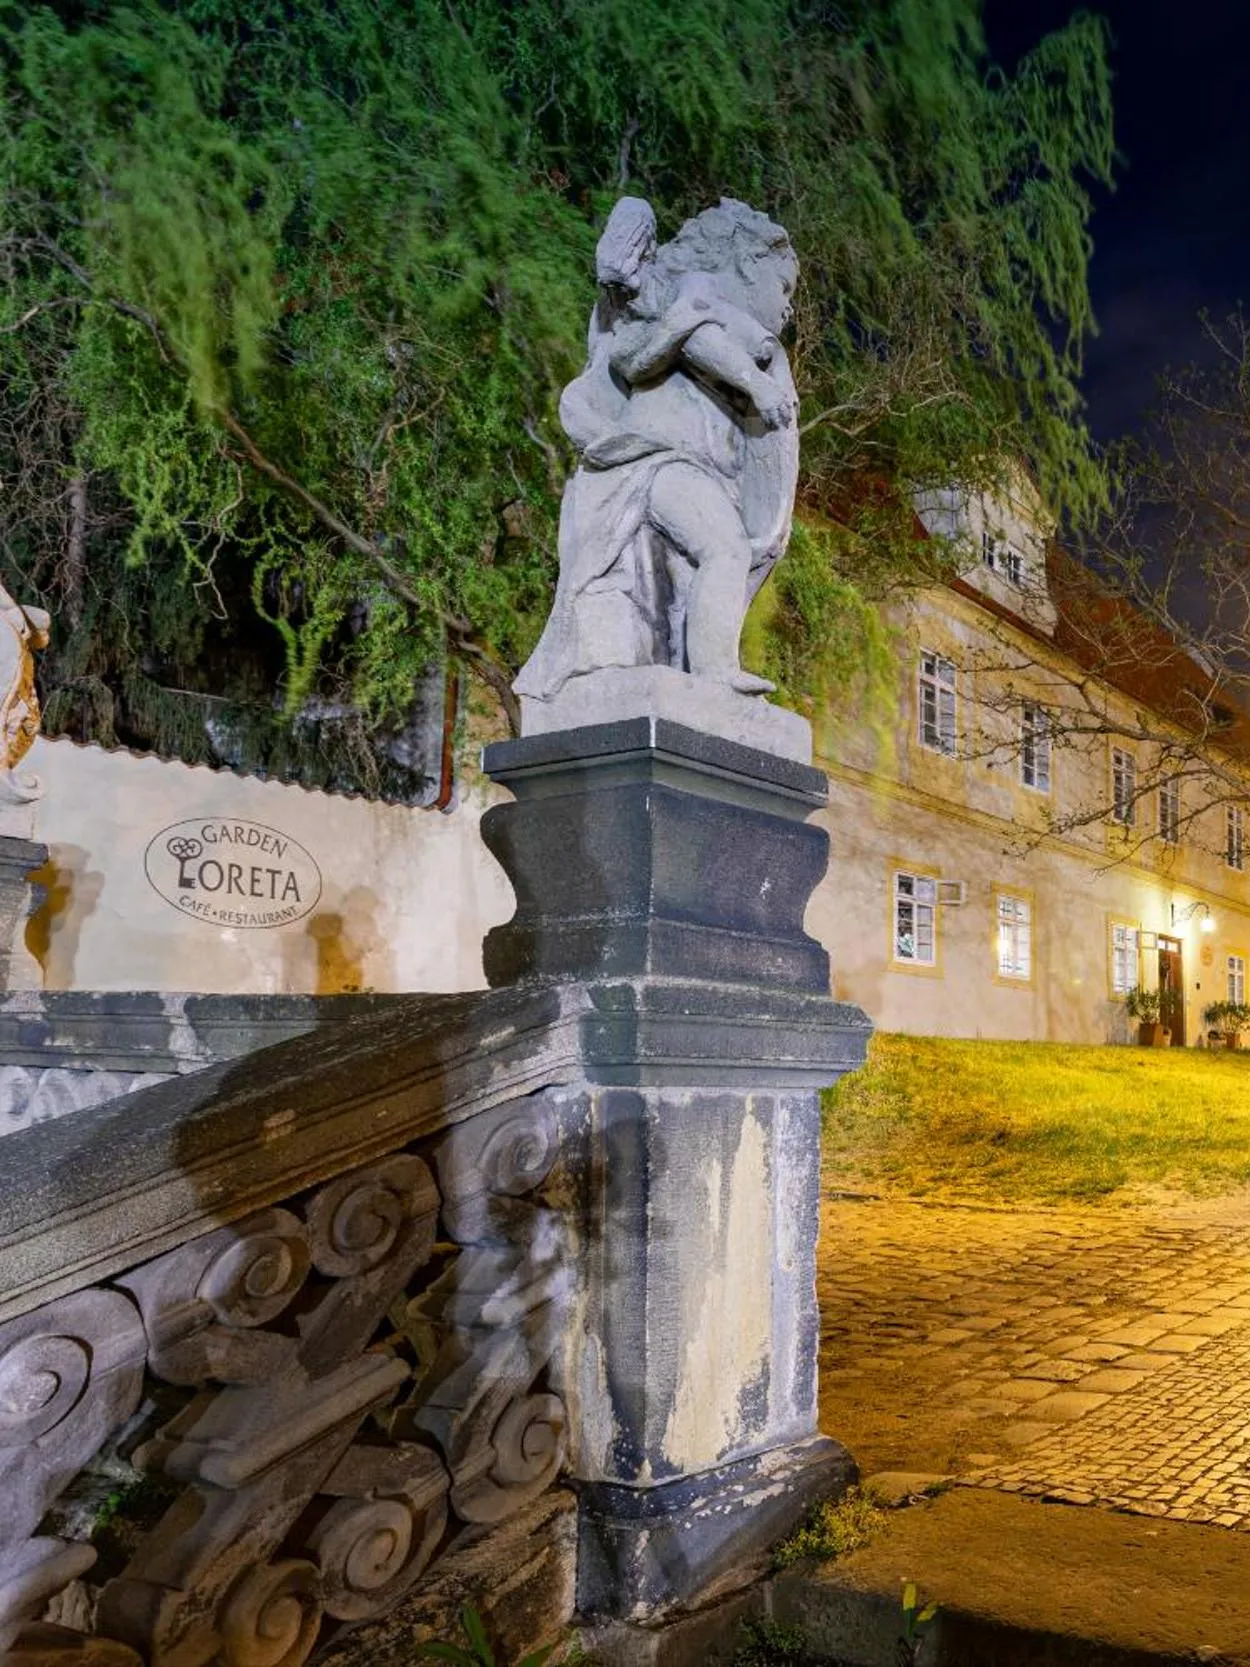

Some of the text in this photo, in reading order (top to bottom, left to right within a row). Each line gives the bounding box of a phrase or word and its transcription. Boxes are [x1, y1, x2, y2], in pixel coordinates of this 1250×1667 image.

[201, 824, 288, 859] GARDEN
[167, 836, 301, 903] LORETA
[219, 904, 300, 925] RESTAURANT
